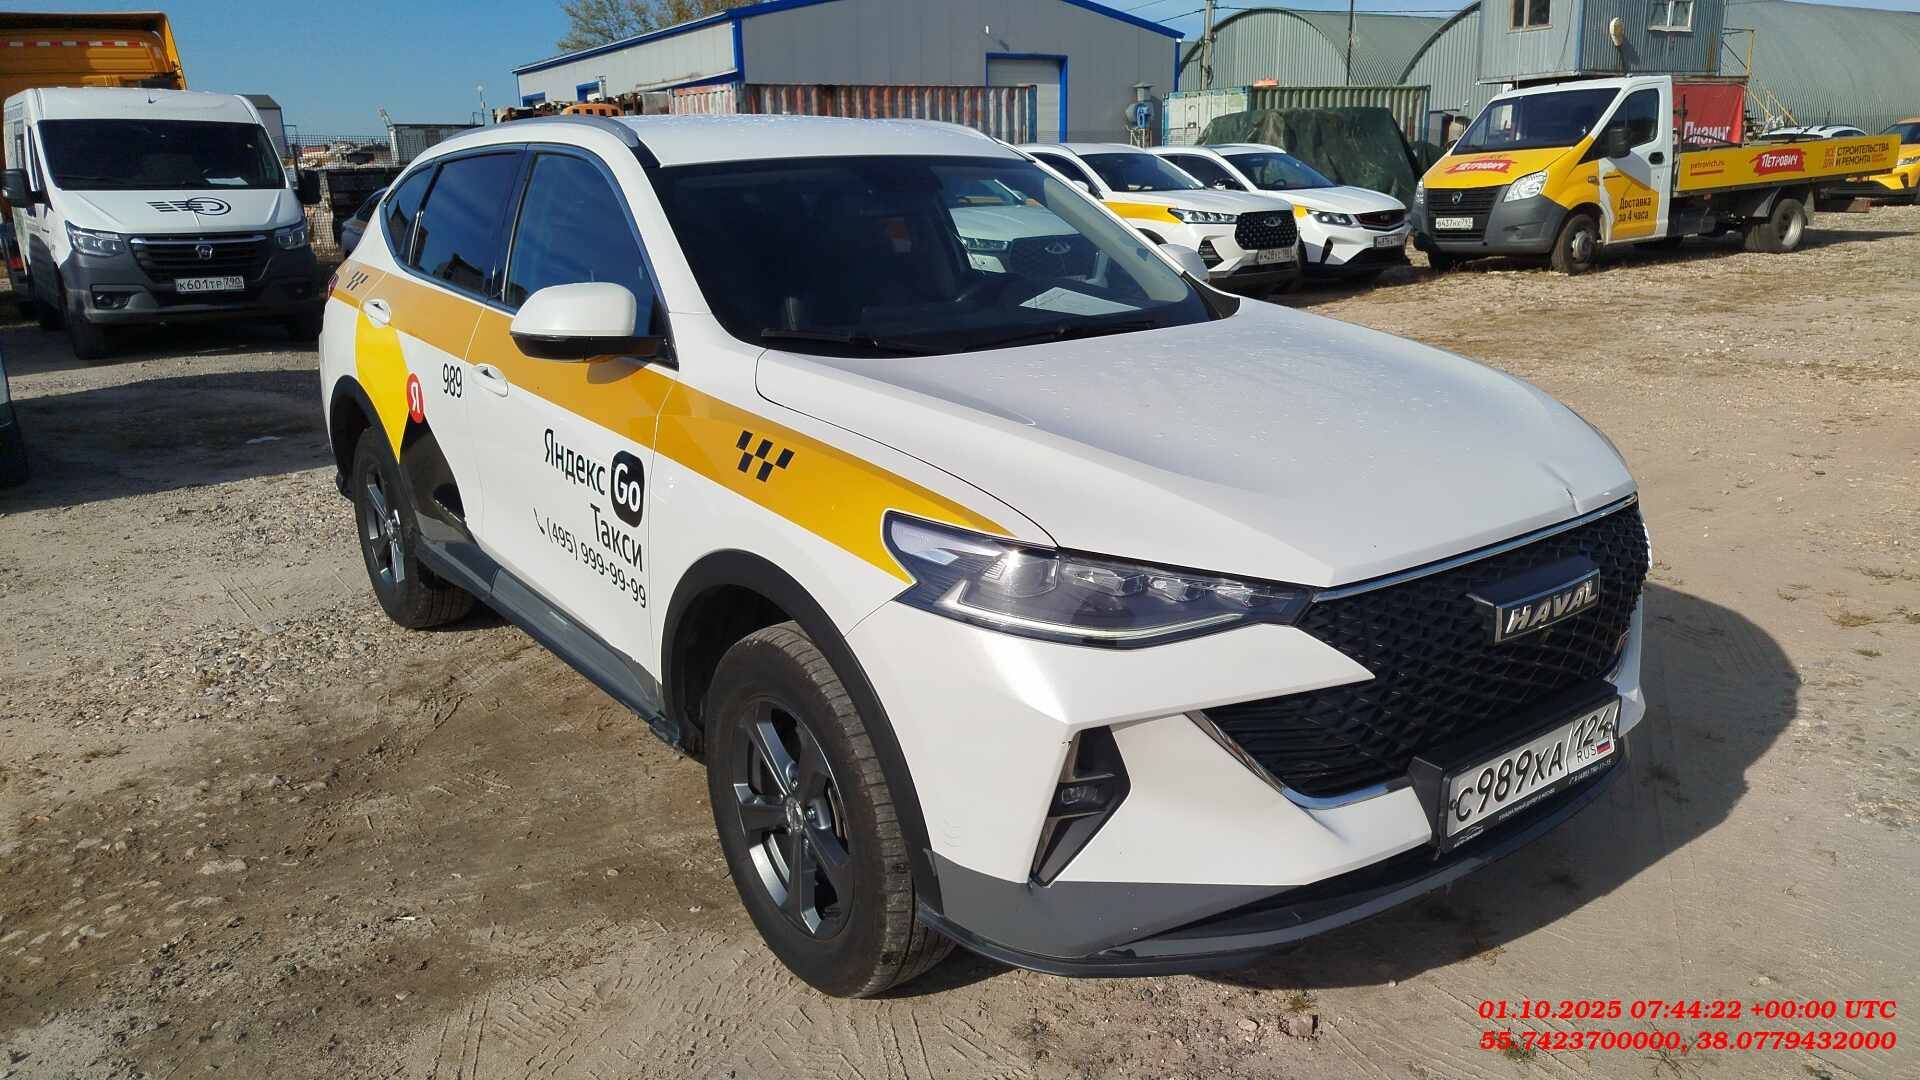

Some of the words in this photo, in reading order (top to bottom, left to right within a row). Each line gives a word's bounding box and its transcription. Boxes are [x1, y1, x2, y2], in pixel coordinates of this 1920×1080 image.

[1837, 143, 1889, 157] СТРОИТЕЛЬСТВА
[1619, 197, 1651, 210] Доставка
[1627, 210, 1632, 222] 4
[1633, 210, 1648, 220] часа
[443, 363, 462, 398] 989
[544, 428, 605, 495] Яндекс
[614, 463, 641, 512] Go
[590, 503, 643, 572] Такси
[546, 517, 578, 560] (495)
[581, 542, 646, 608] 999-99-99
[1505, 580, 1597, 634] HAVAL
[1576, 744, 1597, 763] RUS
